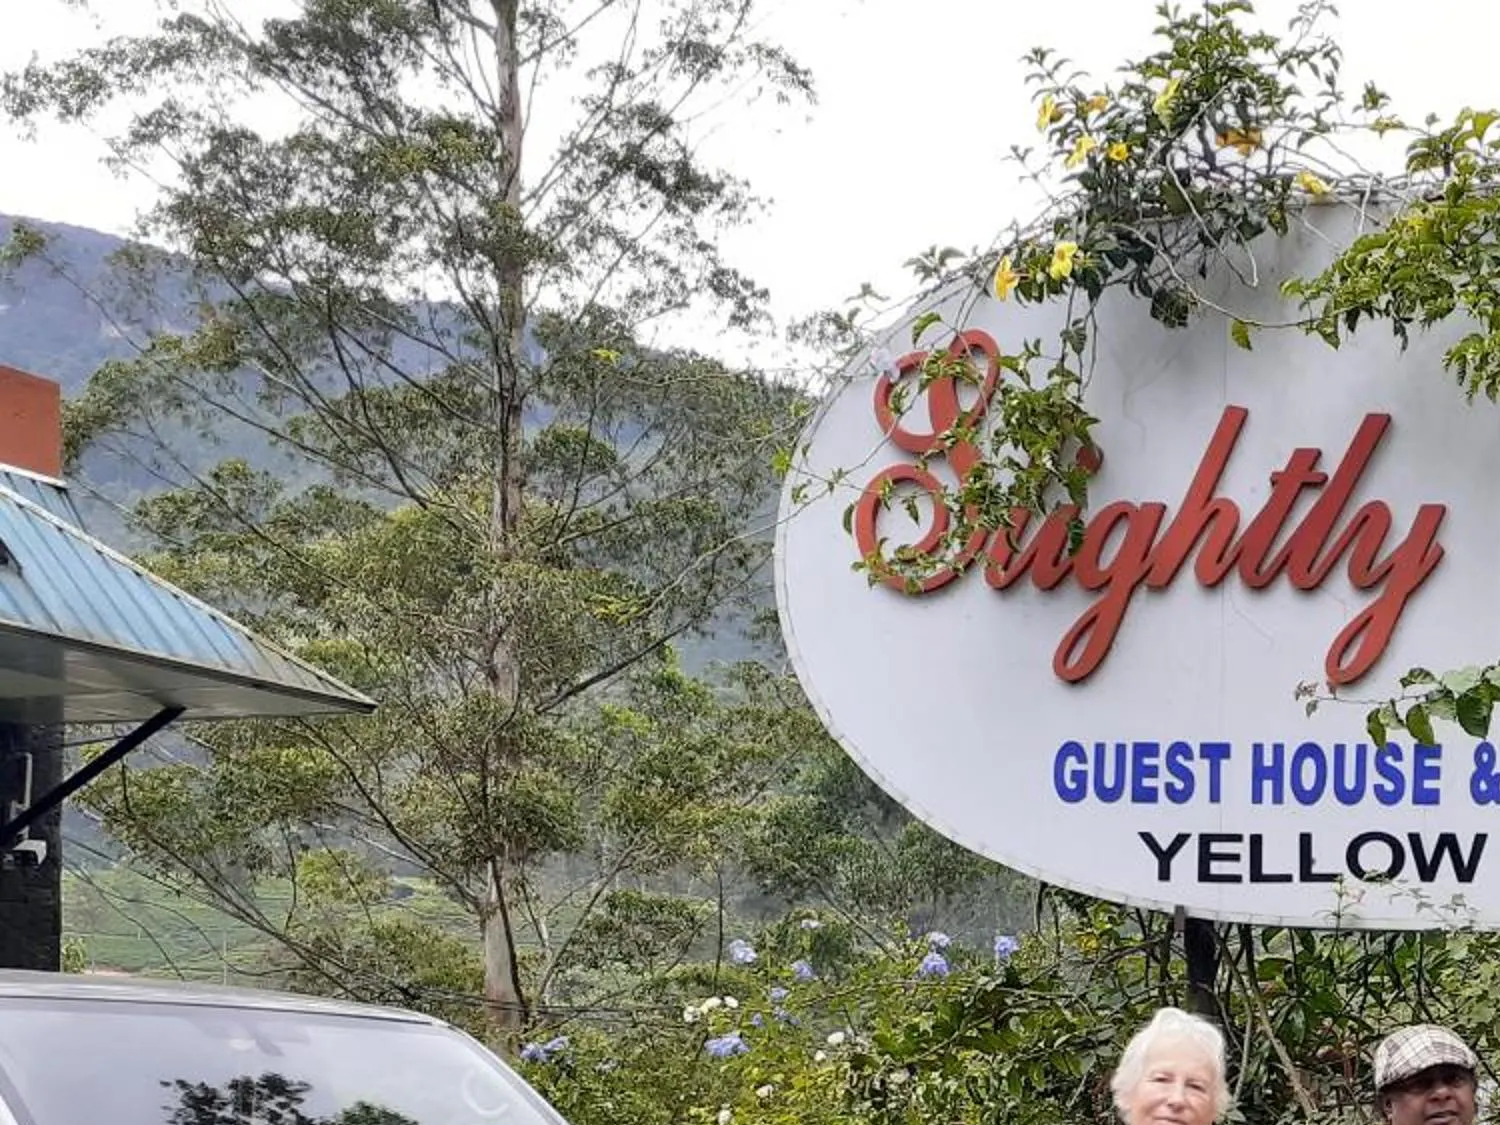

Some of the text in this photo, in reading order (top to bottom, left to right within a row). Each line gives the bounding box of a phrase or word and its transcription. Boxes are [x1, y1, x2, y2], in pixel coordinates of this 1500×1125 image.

[1053, 741, 1231, 804] GUEST
[1251, 741, 1442, 806] HOUSE
[1138, 831, 1488, 884] YELLOW
